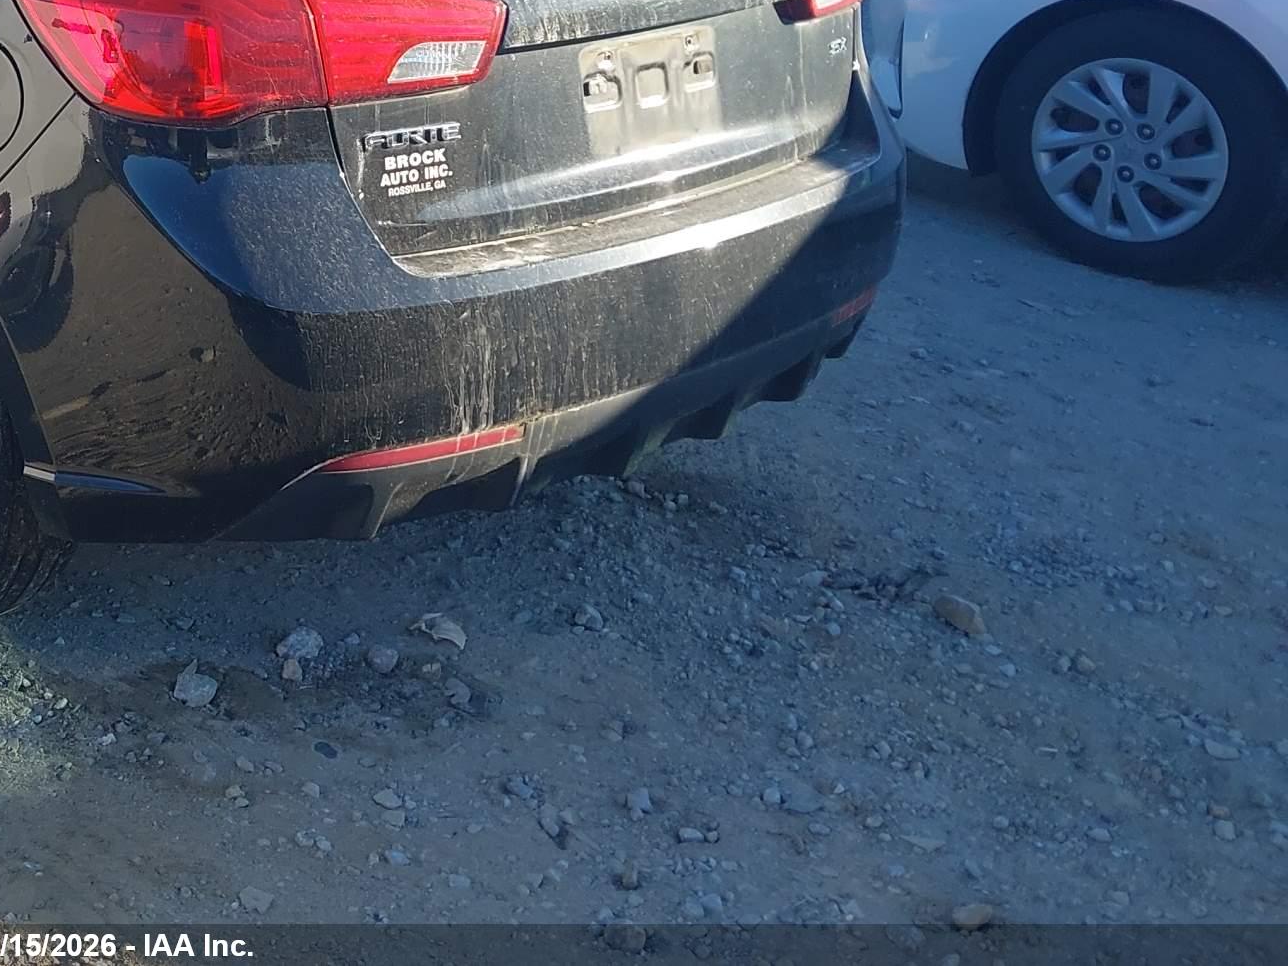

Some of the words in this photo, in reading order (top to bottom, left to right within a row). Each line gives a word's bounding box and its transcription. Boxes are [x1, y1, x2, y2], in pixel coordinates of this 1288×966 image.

[362, 121, 462, 150] FORTE
[384, 147, 447, 171] BROCK
[380, 169, 420, 187] AUTO
[424, 164, 453, 180] INC.
[388, 181, 433, 197] ROSSVILLE,
[435, 179, 447, 190] GA
